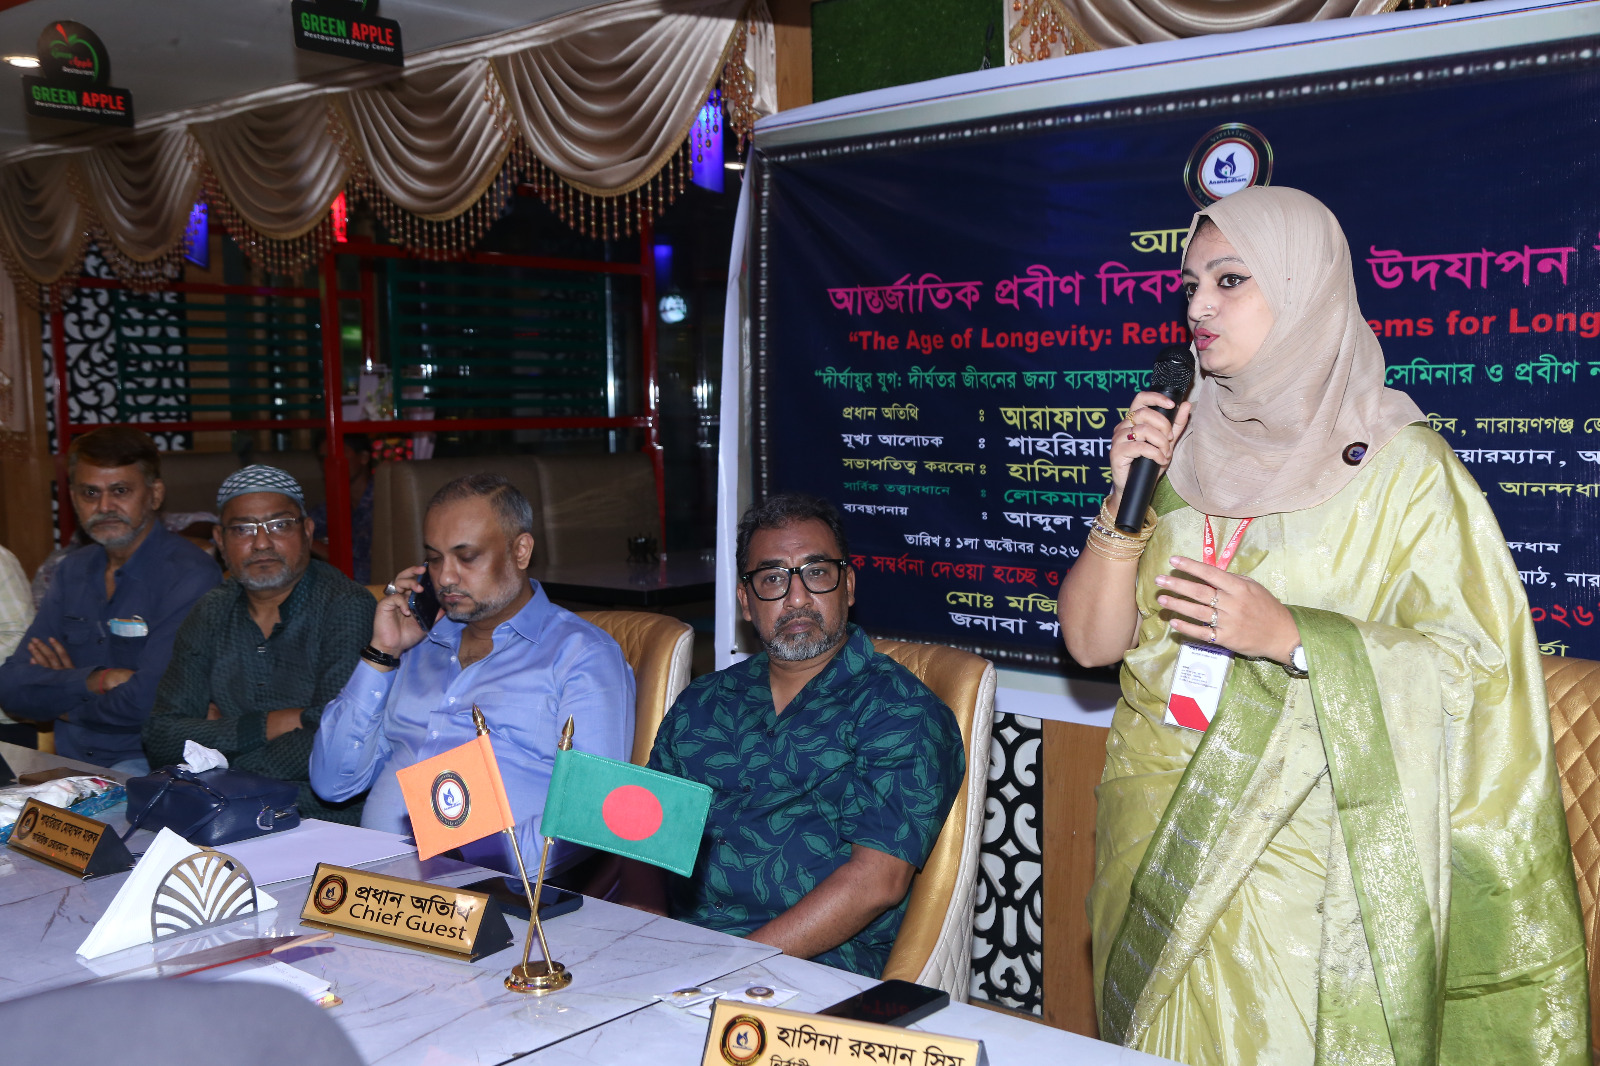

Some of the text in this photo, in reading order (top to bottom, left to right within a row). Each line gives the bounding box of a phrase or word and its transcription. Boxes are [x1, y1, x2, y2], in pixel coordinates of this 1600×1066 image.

[301, 11, 395, 47] GREEN APPLE
[303, 30, 345, 45] Restaurant
[351, 40, 370, 49] Party
[371, 43, 395, 53] Center
[31, 85, 126, 111] GREEN APPLE
[827, 272, 983, 316] আন্তর্জাতিক
[995, 264, 1085, 311] প্রবীণ
[1365, 244, 1577, 291] উদযাপন
[906, 330, 943, 356] Age
[950, 327, 971, 350] of
[981, 324, 1112, 358] Longevity:
[1122, 320, 1193, 346] Reth
[1446, 309, 1497, 336] for
[907, 364, 957, 389] দীর্ঘতর
[961, 364, 1017, 389] জীবনের
[1022, 370, 1057, 390] জন্য
[1384, 357, 1476, 385] সেমিনার
[1485, 364, 1503, 383] ও
[1515, 353, 1581, 386] প্রবীণ
[842, 405, 877, 421] প্রধান
[881, 402, 919, 421] অতিথি
[999, 404, 1109, 432] আরাফাত
[1474, 416, 1575, 435] নারায়ণগঞ্জ
[877, 433, 944, 448] আলোচক
[1453, 447, 1567, 468] য়ারম্যান,
[842, 455, 918, 476] সভাপতিত্ব
[923, 460, 975, 475] করবেন
[1005, 458, 1091, 485] হাসিনা
[1004, 488, 1106, 508] লোকমান
[843, 502, 909, 517] ব্যবস্থাপনায়
[1003, 510, 1074, 533] আব্দুল
[904, 531, 942, 548] তারিখ
[956, 536, 980, 550] ১লা
[984, 536, 1035, 554] অক্টোবর
[1039, 543, 1080, 559] ২০২৬
[872, 553, 924, 577] সম্বর্ধনা
[931, 560, 986, 581] দেওয়া
[992, 564, 1038, 587] হচ্ছে
[1045, 570, 1059, 587] ও
[946, 590, 994, 608] মোঃ
[949, 611, 1028, 634] জনাবা
[354, 885, 405, 910] প্রধান
[349, 902, 468, 941] Chief Guest
[776, 1024, 843, 1056] হাসিনা
[848, 1038, 917, 1066] রহমান
